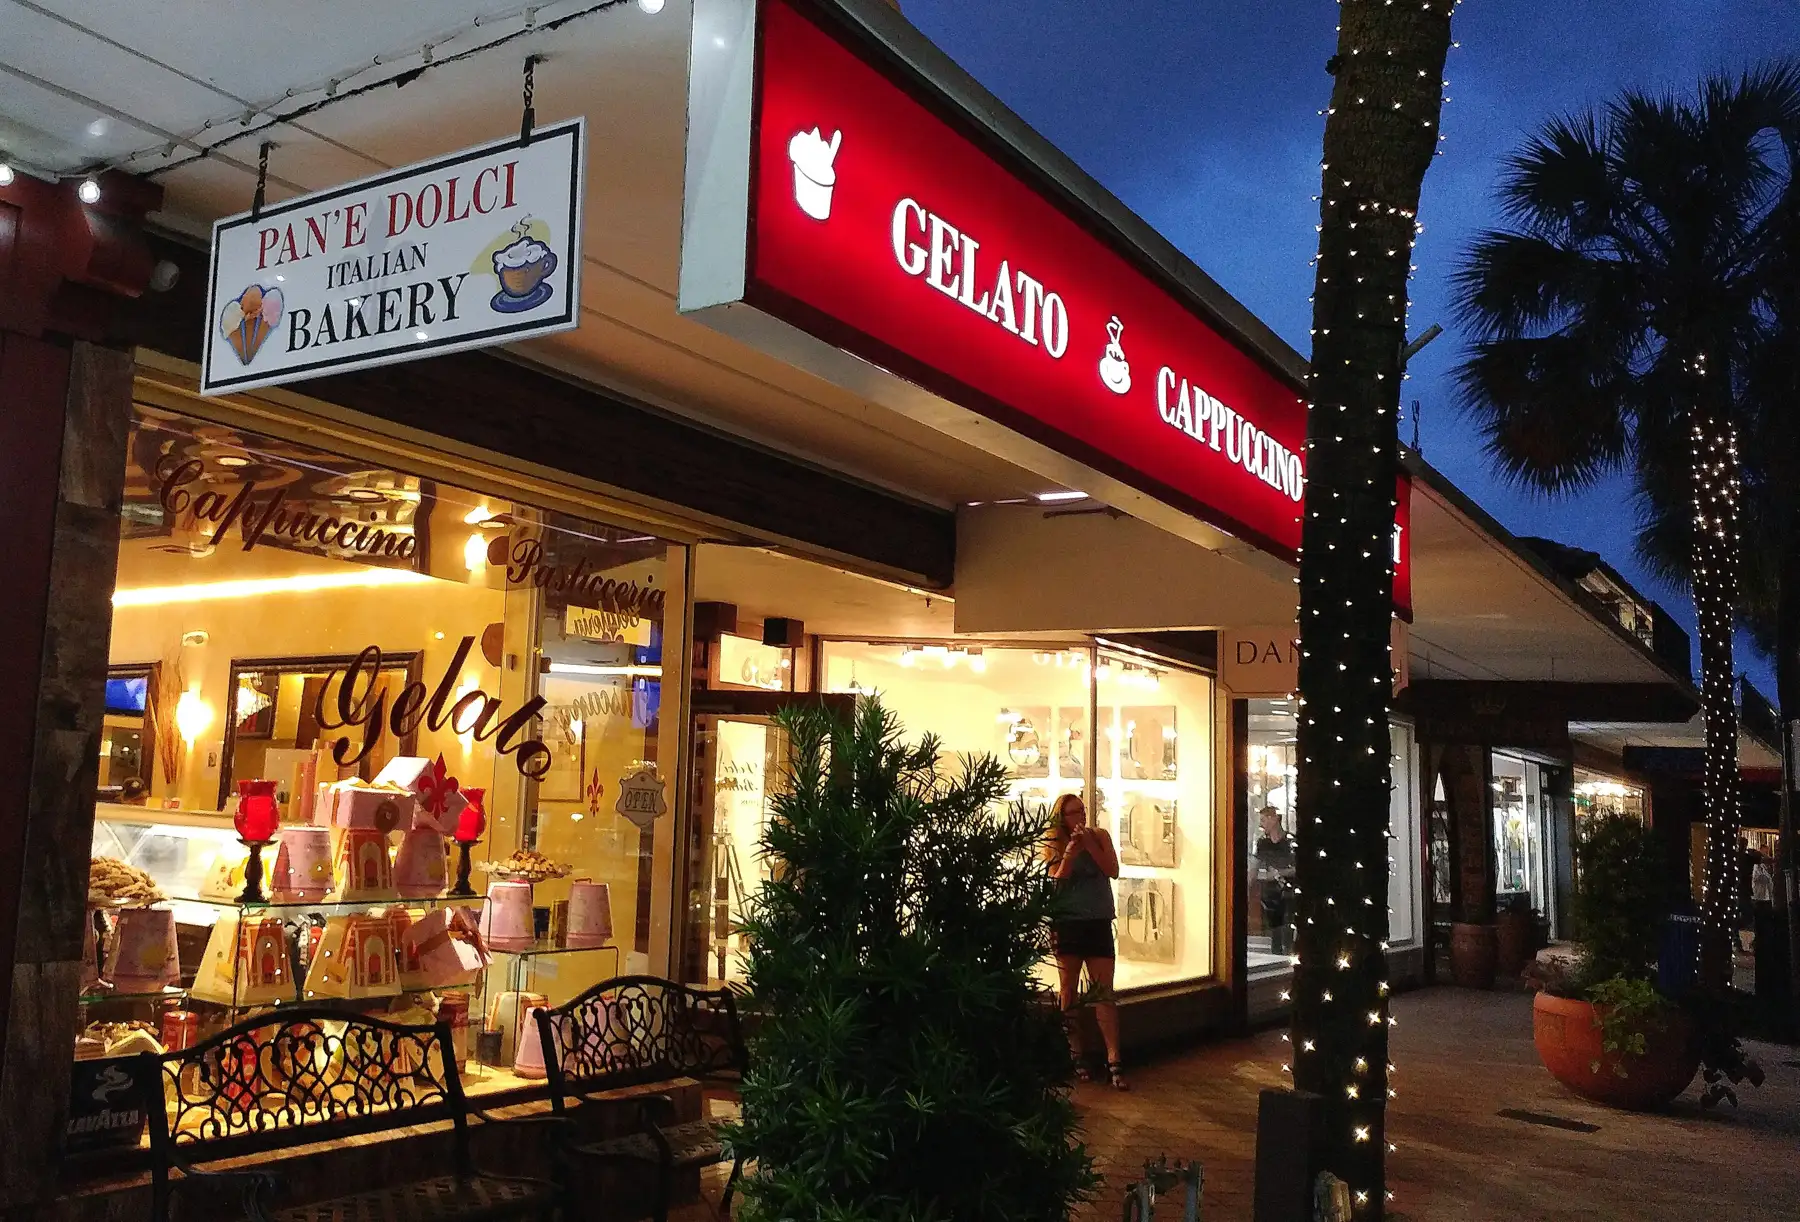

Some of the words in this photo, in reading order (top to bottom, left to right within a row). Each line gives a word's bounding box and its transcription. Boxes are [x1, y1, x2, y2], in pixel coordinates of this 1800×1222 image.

[256, 202, 367, 270] PAN'E
[387, 161, 519, 237] DOLCI
[327, 242, 428, 289] ITALIAN
[286, 272, 470, 352] BAKERY
[891, 197, 1068, 359] GELATO
[1156, 366, 1303, 502] CAPPUCCINO
[155, 454, 417, 560] Cappuccino
[506, 538, 665, 611] Pasticceria
[1236, 640, 1300, 665] DAN
[316, 635, 553, 783] Gelato
[624, 790, 659, 813] OPEN
